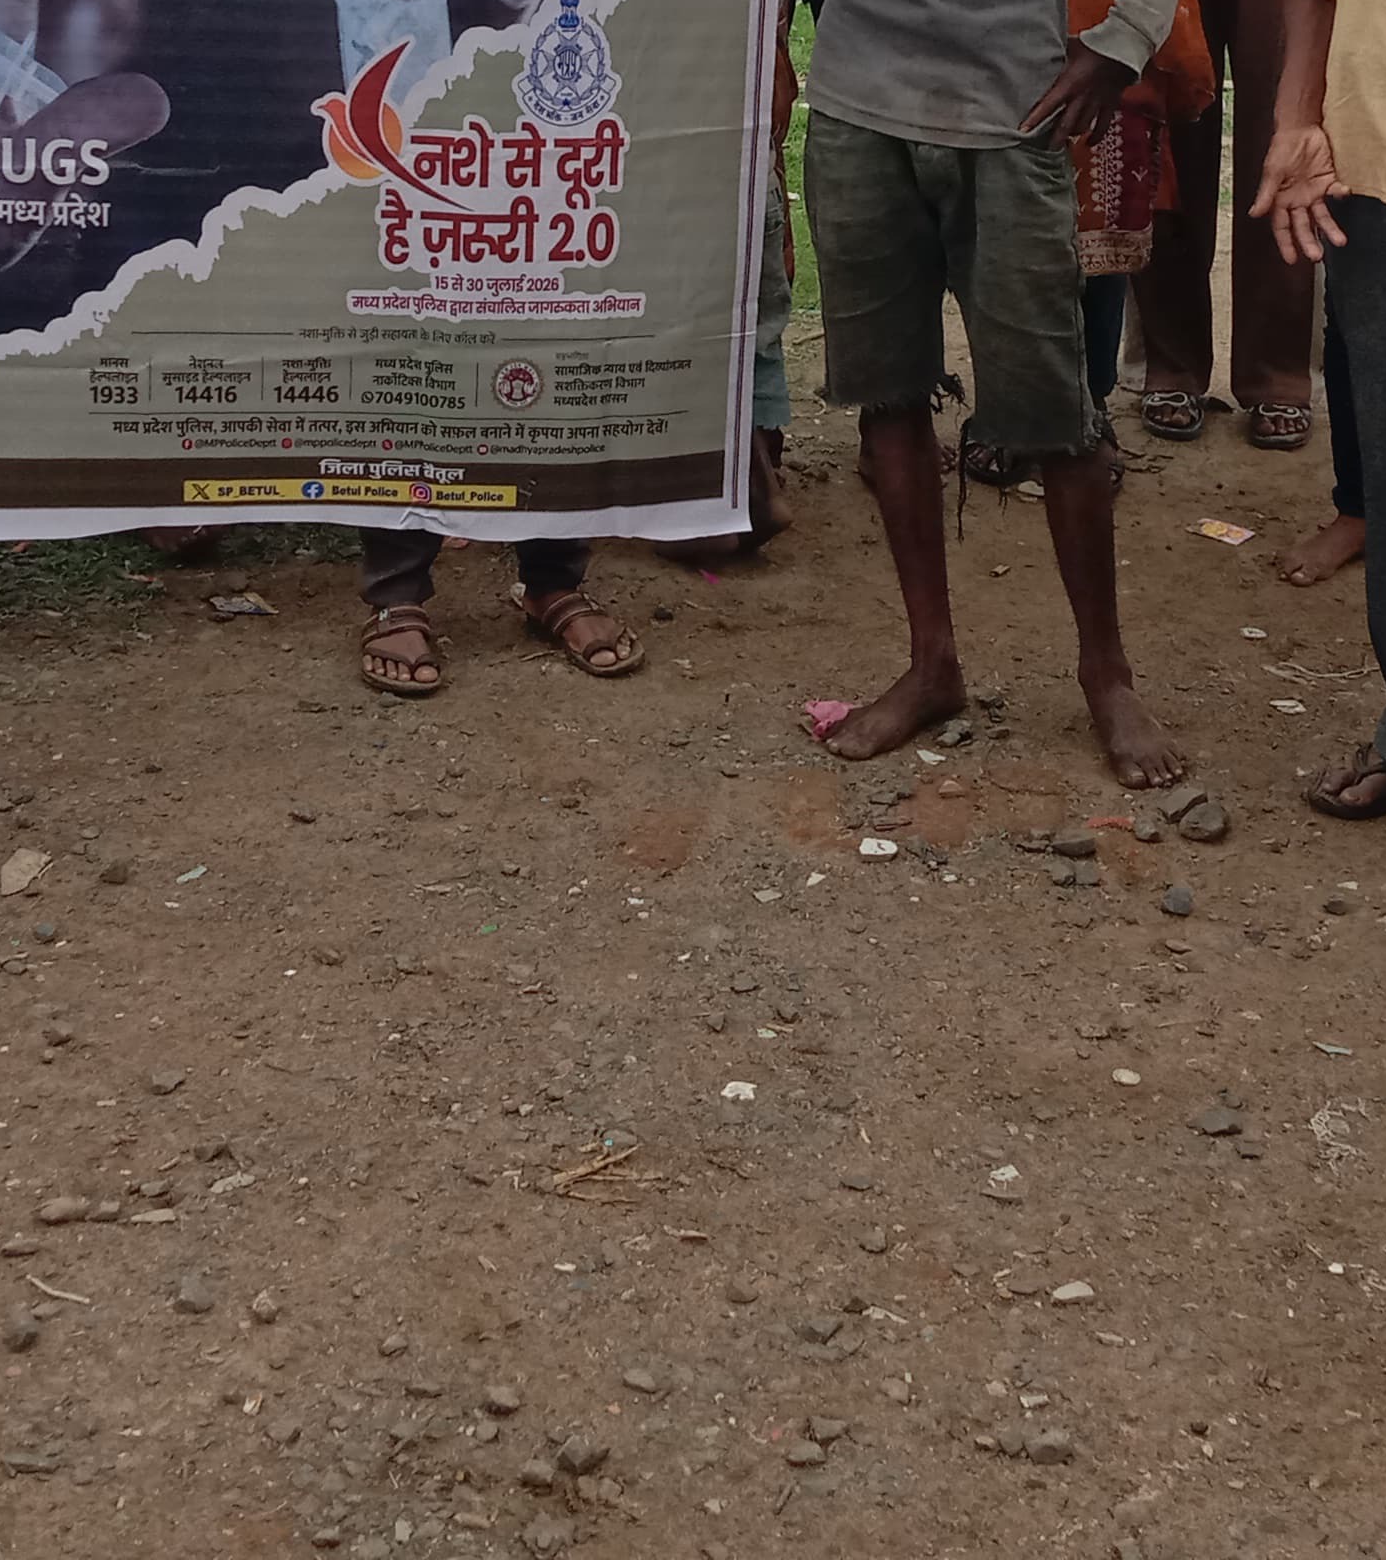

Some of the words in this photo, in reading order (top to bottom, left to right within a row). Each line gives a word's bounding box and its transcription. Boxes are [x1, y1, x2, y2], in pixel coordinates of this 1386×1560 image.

[410, 121, 495, 188] नशे
[502, 121, 547, 188] से
[554, 119, 625, 209] दूरी
[52, 193, 111, 228] प्रदेश
[381, 188, 413, 265] है
[420, 195, 539, 269] ज़रूरी
[548, 212, 614, 263] 2.0
[435, 276, 449, 289] 15
[451, 273, 465, 290] से
[467, 278, 484, 291] 30
[486, 274, 526, 296] जुलाई
[527, 278, 560, 291] 2026
[352, 295, 380, 309] मध्य
[383, 293, 411, 309] प्रदेश
[413, 294, 448, 314] पुलिस
[450, 299, 473, 316] द्वारा
[476, 297, 526, 314] संचालित
[593, 296, 641, 313] अभियान
[99, 357, 129, 368] मानस
[375, 358, 397, 368] मध्य
[424, 359, 453, 375] पुलिस
[89, 386, 139, 404] 1933
[175, 385, 238, 404] 14416
[273, 385, 340, 403] 14446
[375, 391, 466, 409] 7049100785
[113, 421, 140, 434] मध्य
[143, 418, 172, 435] प्रदेश
[176, 418, 217, 438] पुलिस,
[221, 417, 262, 433] आपकी
[266, 417, 292, 433] सेवा
[295, 416, 306, 433] में
[345, 420, 364, 434] इस
[369, 420, 417, 433] अभियान
[420, 421, 437, 437] को
[480, 423, 512, 439] बनाने
[515, 421, 525, 439] में
[528, 426, 563, 442] कृपया
[566, 426, 599, 439] अपना
[602, 423, 644, 437] सहयोग
[318, 458, 364, 476] जिला
[369, 460, 421, 479] पुलिस
[423, 461, 464, 483] बैतूल
[332, 485, 361, 496] Betul
[364, 486, 398, 498] Police
[436, 490, 504, 502] Betul_Police
